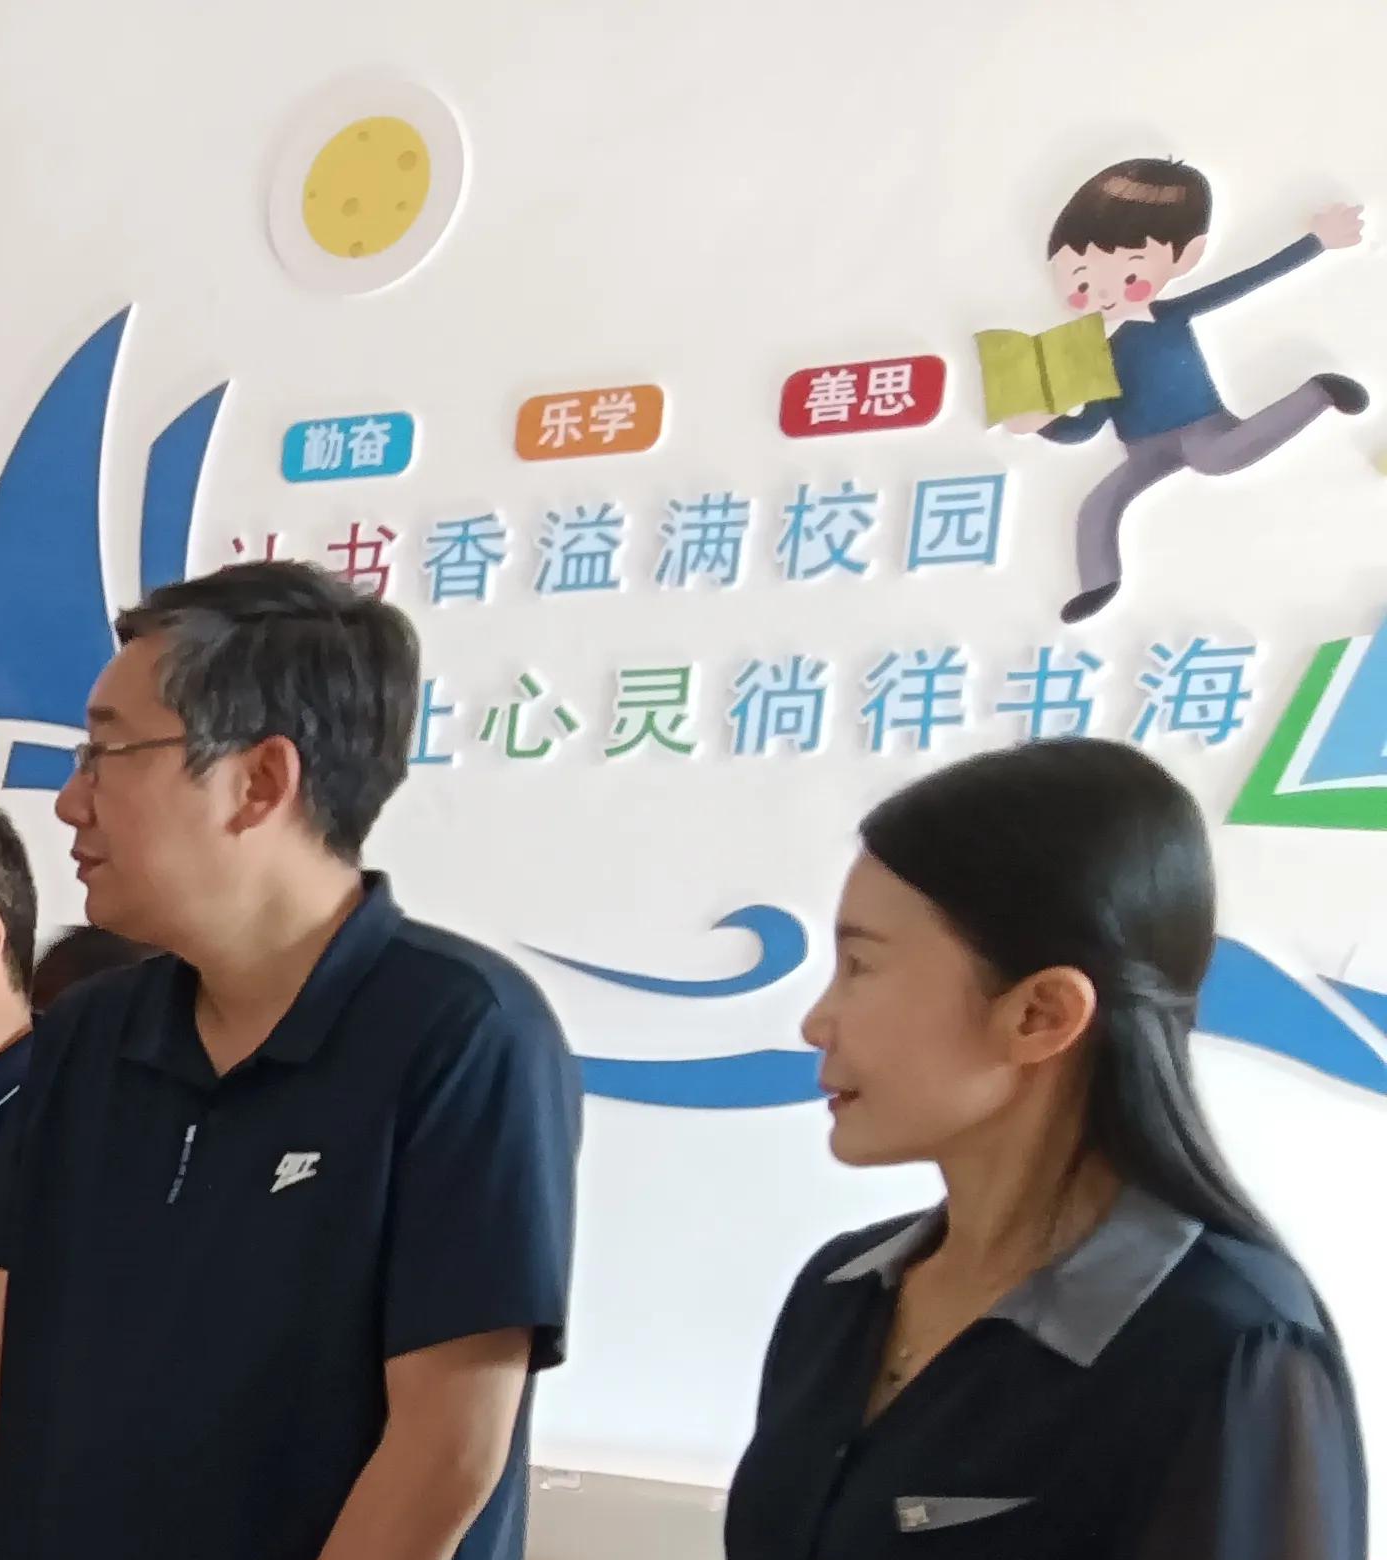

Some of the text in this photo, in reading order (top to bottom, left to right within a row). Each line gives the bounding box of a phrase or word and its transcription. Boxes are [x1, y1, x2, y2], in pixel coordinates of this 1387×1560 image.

[538, 392, 637, 448] 乐学
[804, 362, 916, 426] 善思
[301, 418, 392, 474] 勤奋
[231, 473, 1008, 604] 书香溢满校园
